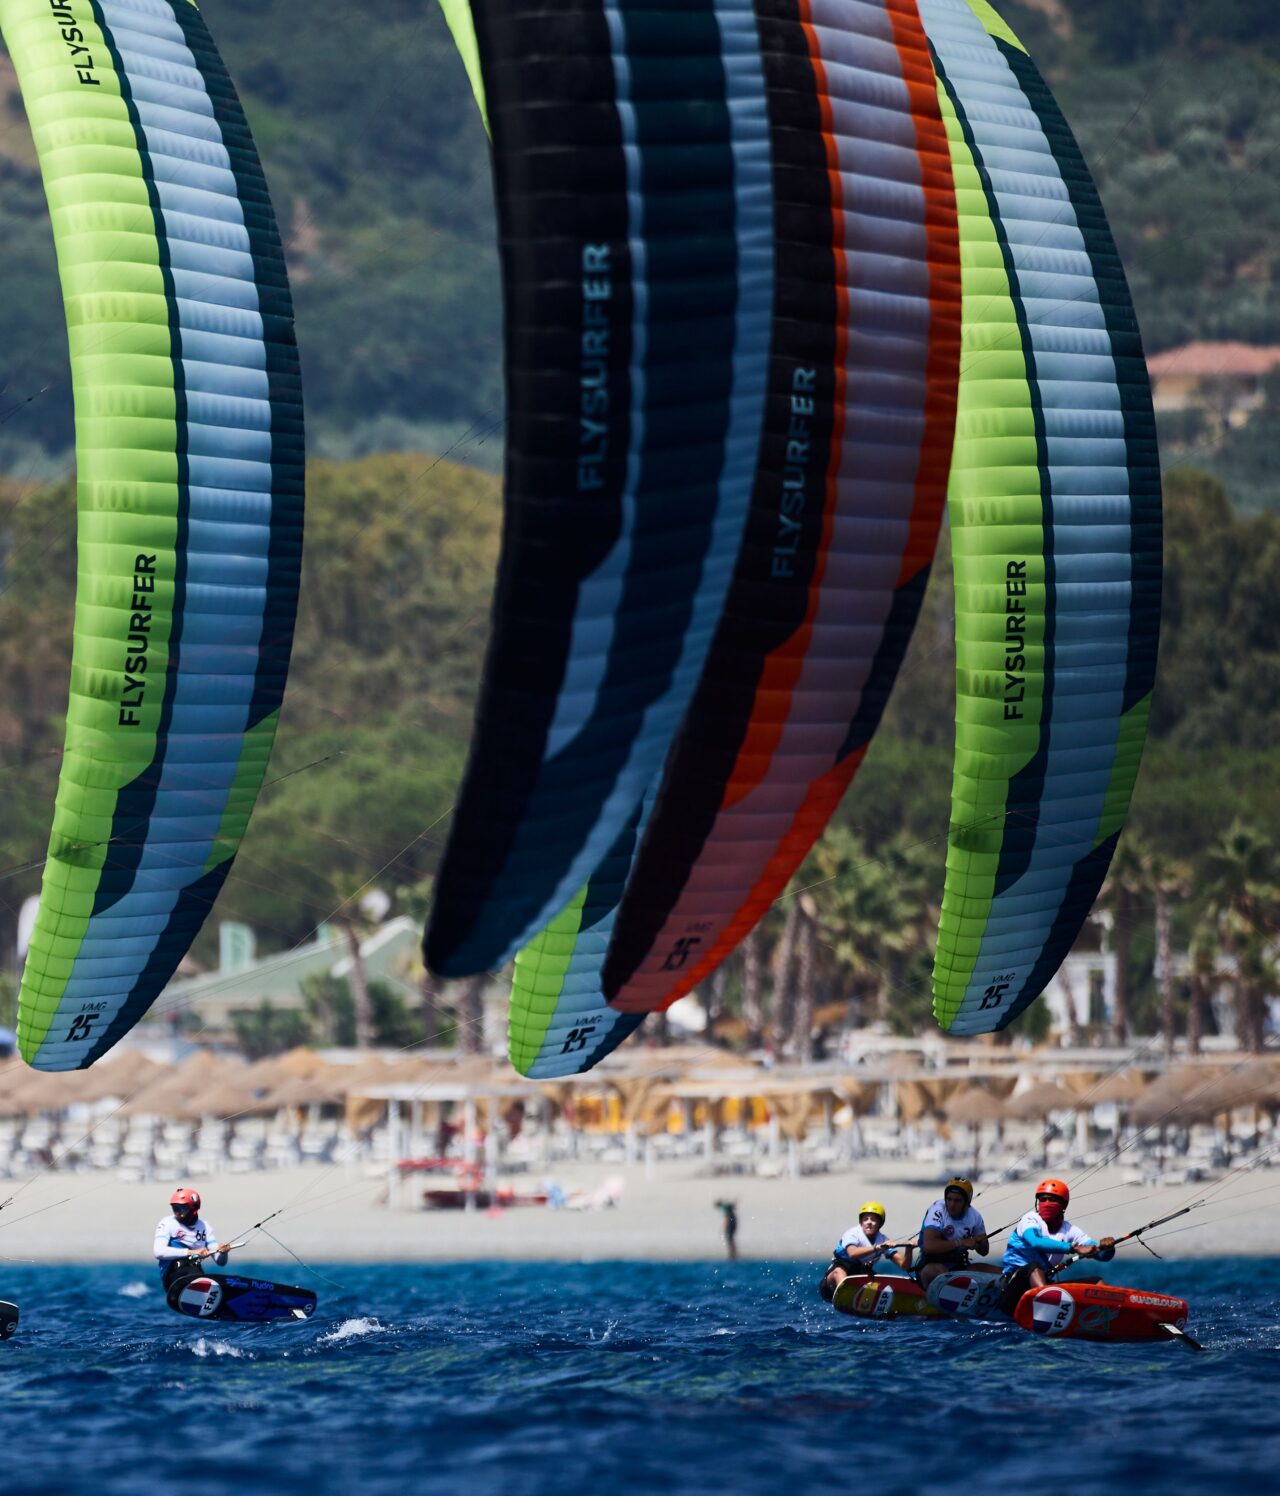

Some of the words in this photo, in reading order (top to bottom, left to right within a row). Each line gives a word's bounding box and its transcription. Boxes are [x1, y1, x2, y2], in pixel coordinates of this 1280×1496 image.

[577, 242, 612, 491] FLYSURFER
[773, 367, 816, 577] FLYSURFER
[118, 553, 157, 726] FLYSURFER
[1003, 560, 1027, 721] FLYSURFER
[992, 972, 1016, 984] VMG
[81, 1002, 108, 1012] VMG
[977, 983, 1010, 1011] 15
[64, 1013, 100, 1042] 15
[575, 1015, 603, 1026] VMG
[560, 1026, 596, 1054] 15
[196, 1230, 207, 1242] 66
[203, 1290, 219, 1311] FRA
[877, 1292, 889, 1311] ESP
[960, 1287, 978, 1308] FRA
[1054, 1303, 1071, 1328] FRA
